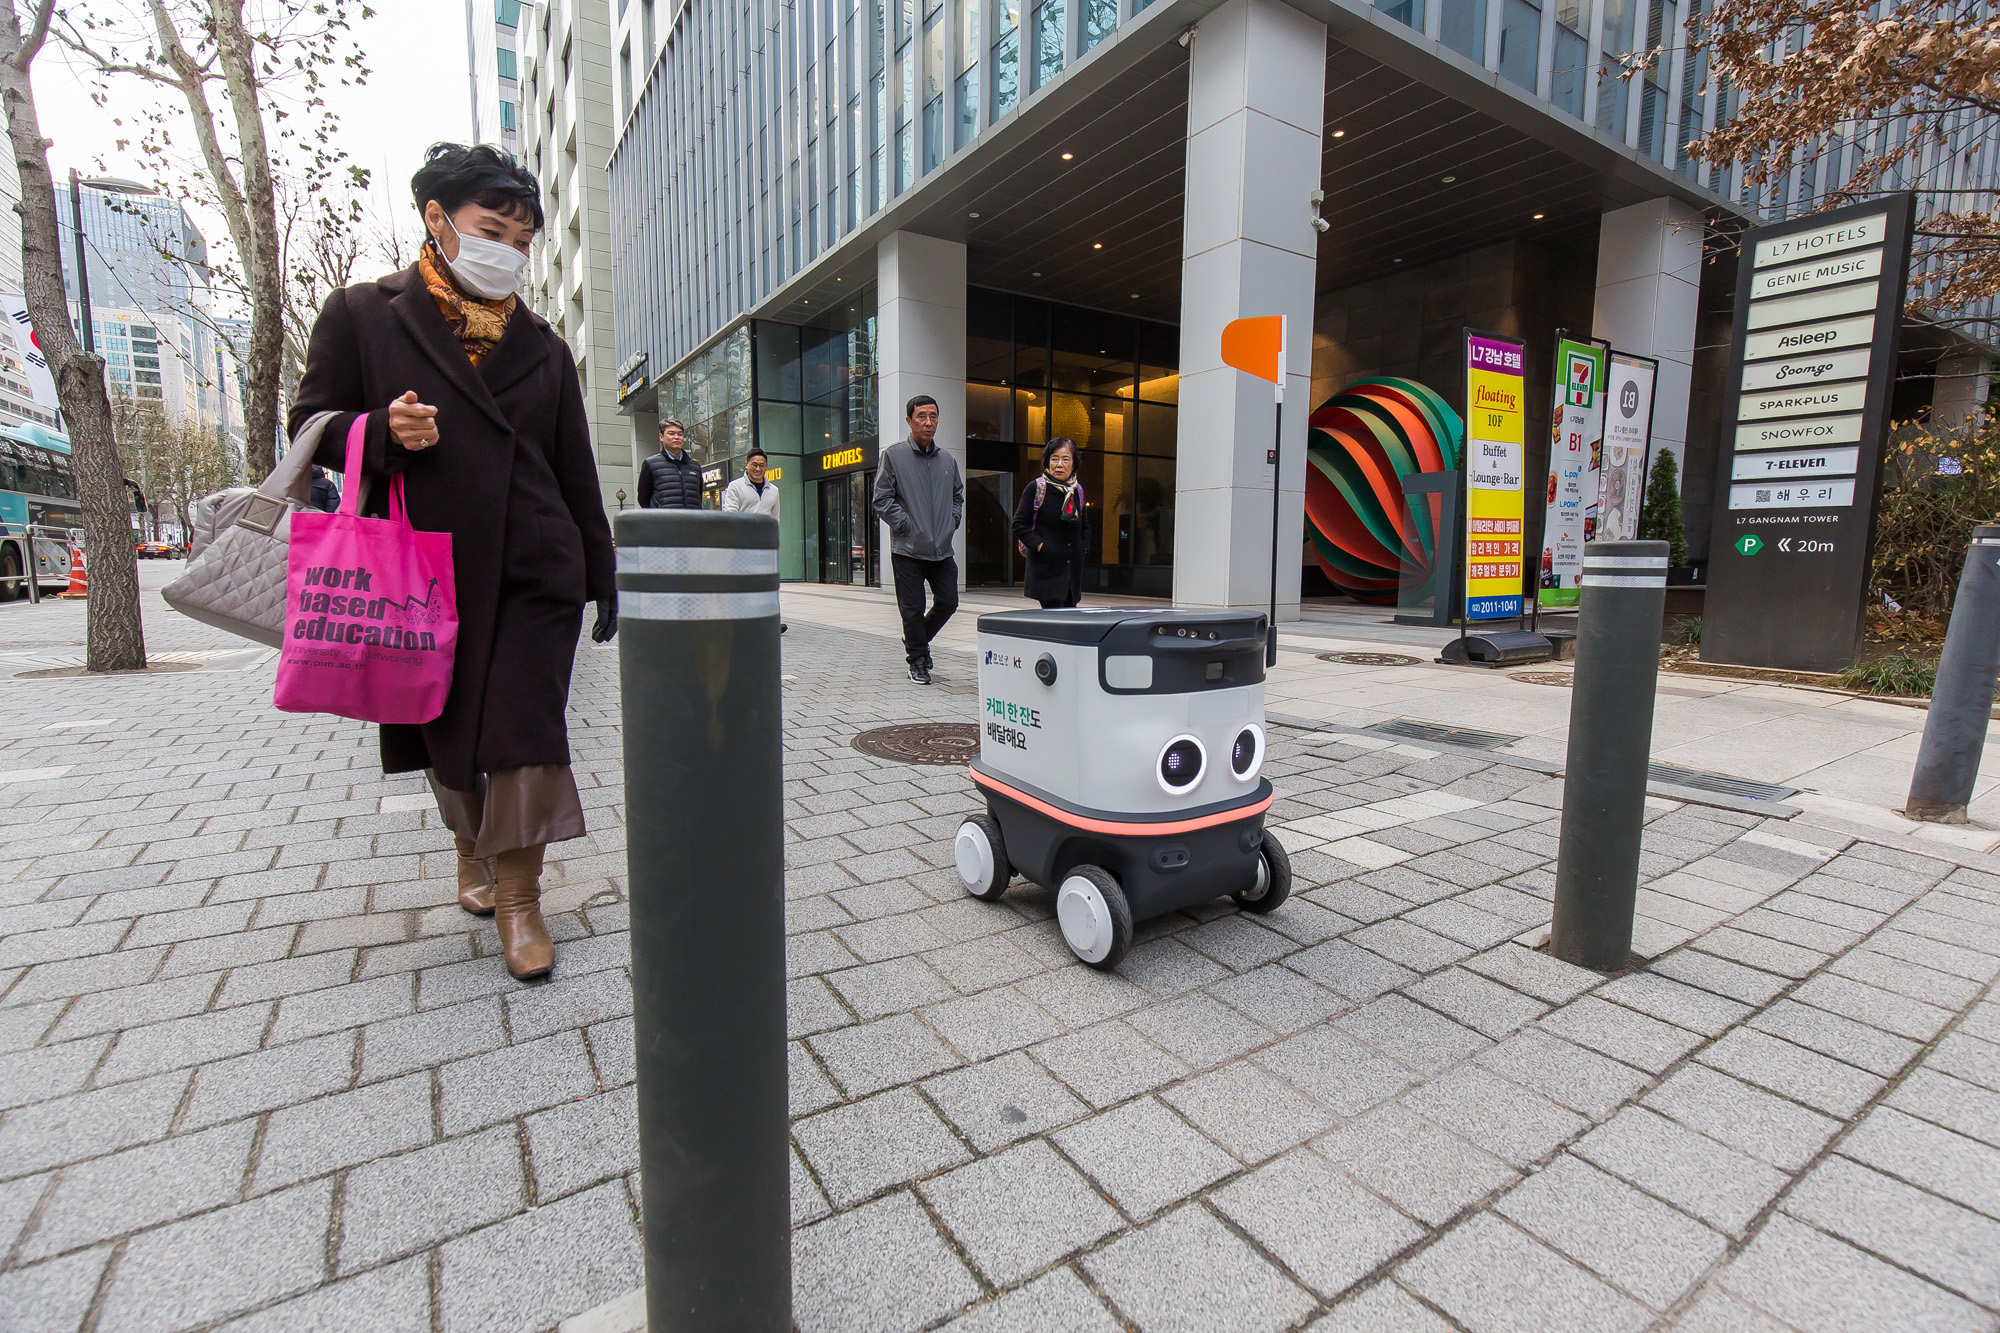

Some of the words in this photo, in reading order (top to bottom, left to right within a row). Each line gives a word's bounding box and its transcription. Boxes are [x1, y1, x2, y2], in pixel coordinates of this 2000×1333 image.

[1772, 243, 1790, 257] L7
[1796, 226, 1866, 250] HOTELS
[1767, 271, 1810, 288] GENIE
[1778, 330, 1837, 348] Asleep
[1472, 345, 1484, 362] L7
[1485, 347, 1503, 366] 강남
[1503, 351, 1521, 369] 호텔
[1775, 363, 1833, 379] Soomgo
[1475, 384, 1516, 410] floating
[1487, 413, 1504, 428] 10F
[1761, 426, 1833, 441] SNOWFOX
[1569, 432, 1582, 453] B1
[823, 454, 832, 470] L7
[832, 447, 863, 468] HOTELS
[1482, 444, 1507, 458] Buffet
[1492, 459, 1497, 468] &
[1493, 520, 1506, 533] 세미
[1748, 516, 1800, 524] GANGNAM
[1803, 515, 1839, 523] TOWER
[1471, 542, 1500, 555] 합리적인
[1503, 542, 1519, 554] 가격
[1744, 538, 1757, 552] P
[1797, 540, 1834, 552] 20m
[1498, 564, 1519, 577] 분위기
[304, 566, 373, 592] work
[299, 589, 385, 620] based
[1480, 600, 1517, 613] 2011-1041
[293, 616, 436, 651] education
[1013, 656, 1022, 669] kt
[986, 697, 1006, 720] 커피
[1007, 702, 1018, 723] 한
[1019, 706, 1042, 730] 잔도
[987, 722, 1027, 750] 배달해요
